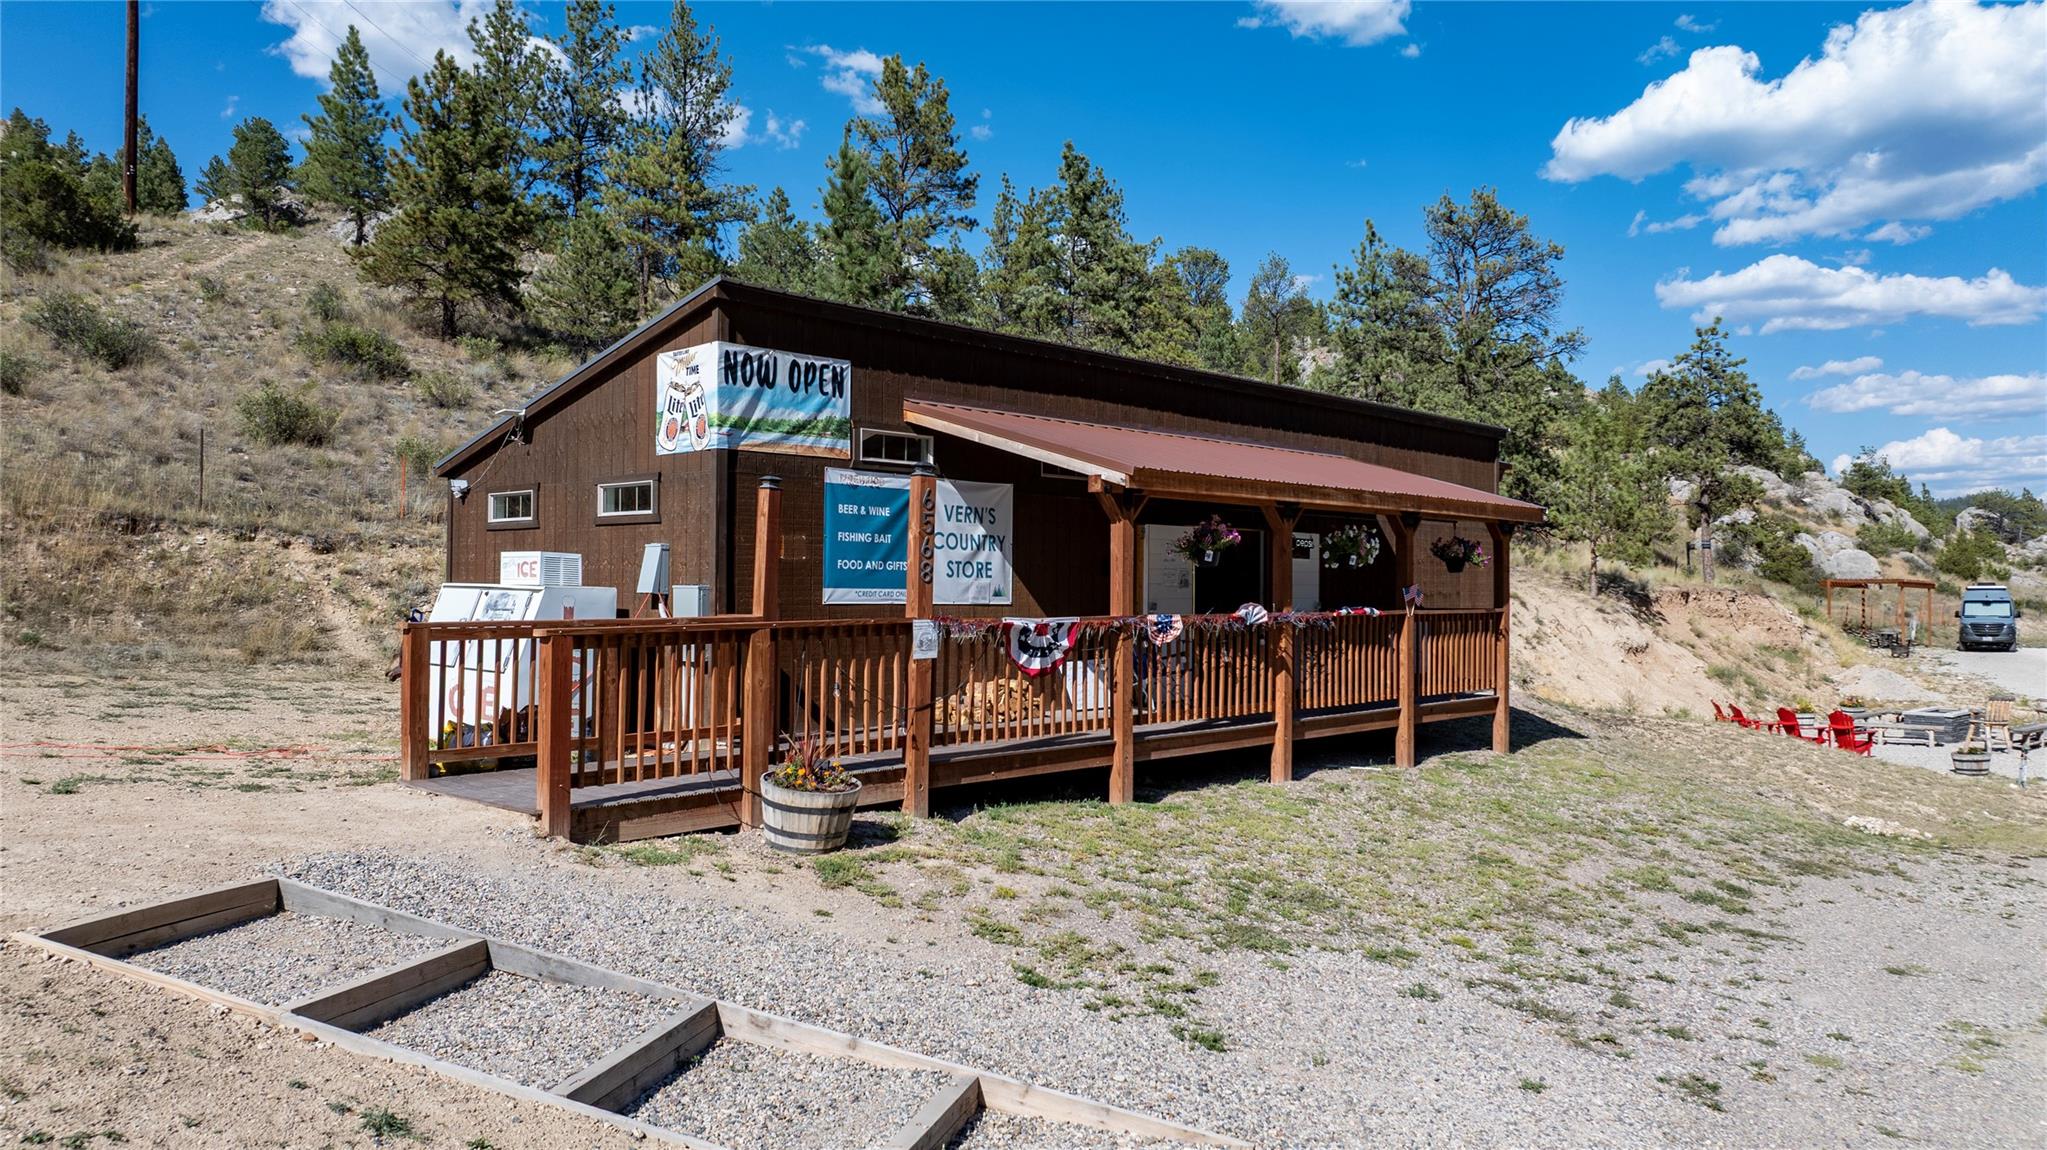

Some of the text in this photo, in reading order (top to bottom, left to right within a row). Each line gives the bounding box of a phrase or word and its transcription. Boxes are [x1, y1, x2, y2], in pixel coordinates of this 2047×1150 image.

[685, 365, 700, 376] TIME
[723, 350, 845, 399] NOW OPEN
[838, 504, 891, 517] BEER & WINE
[944, 504, 997, 525] VERN'S
[837, 532, 892, 544] FISHING BAIT
[920, 487, 935, 585] 6568
[934, 532, 1006, 553] COUNTRY
[517, 560, 538, 577] ICE
[837, 560, 908, 571] FOOD AND GIFTS
[946, 560, 993, 579] STORE
[878, 590, 895, 598] CARD
